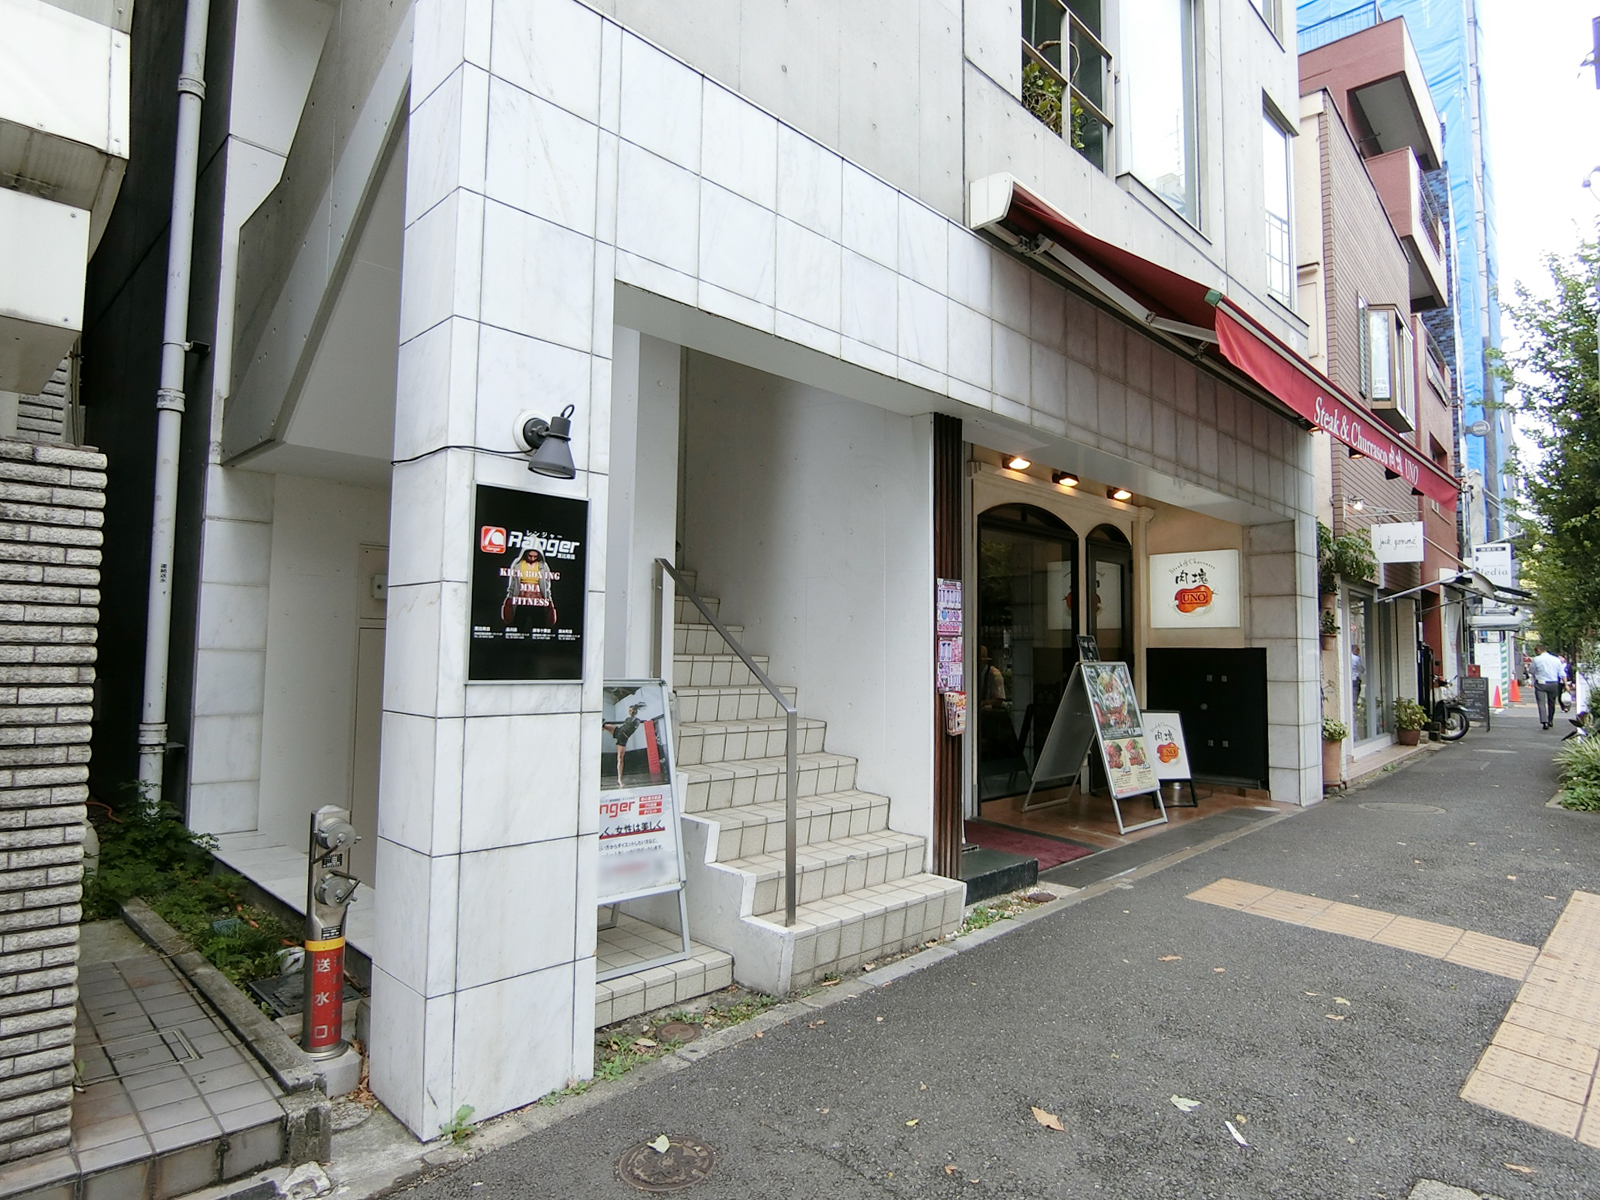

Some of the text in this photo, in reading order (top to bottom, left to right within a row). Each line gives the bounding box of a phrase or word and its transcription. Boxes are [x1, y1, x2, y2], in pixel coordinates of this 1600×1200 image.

[1314, 396, 1340, 438] Steak
[1340, 415, 1350, 442] &
[1351, 422, 1388, 466] Churrasco
[1405, 458, 1419, 486] UNO
[507, 531, 581, 557] Ranger
[500, 567, 523, 578] KICK
[519, 583, 541, 593] MMA
[512, 597, 550, 607] FITNESS
[1183, 593, 1206, 603] UNO
[599, 801, 635, 818] nger
[314, 957, 331, 1040] 送水口
